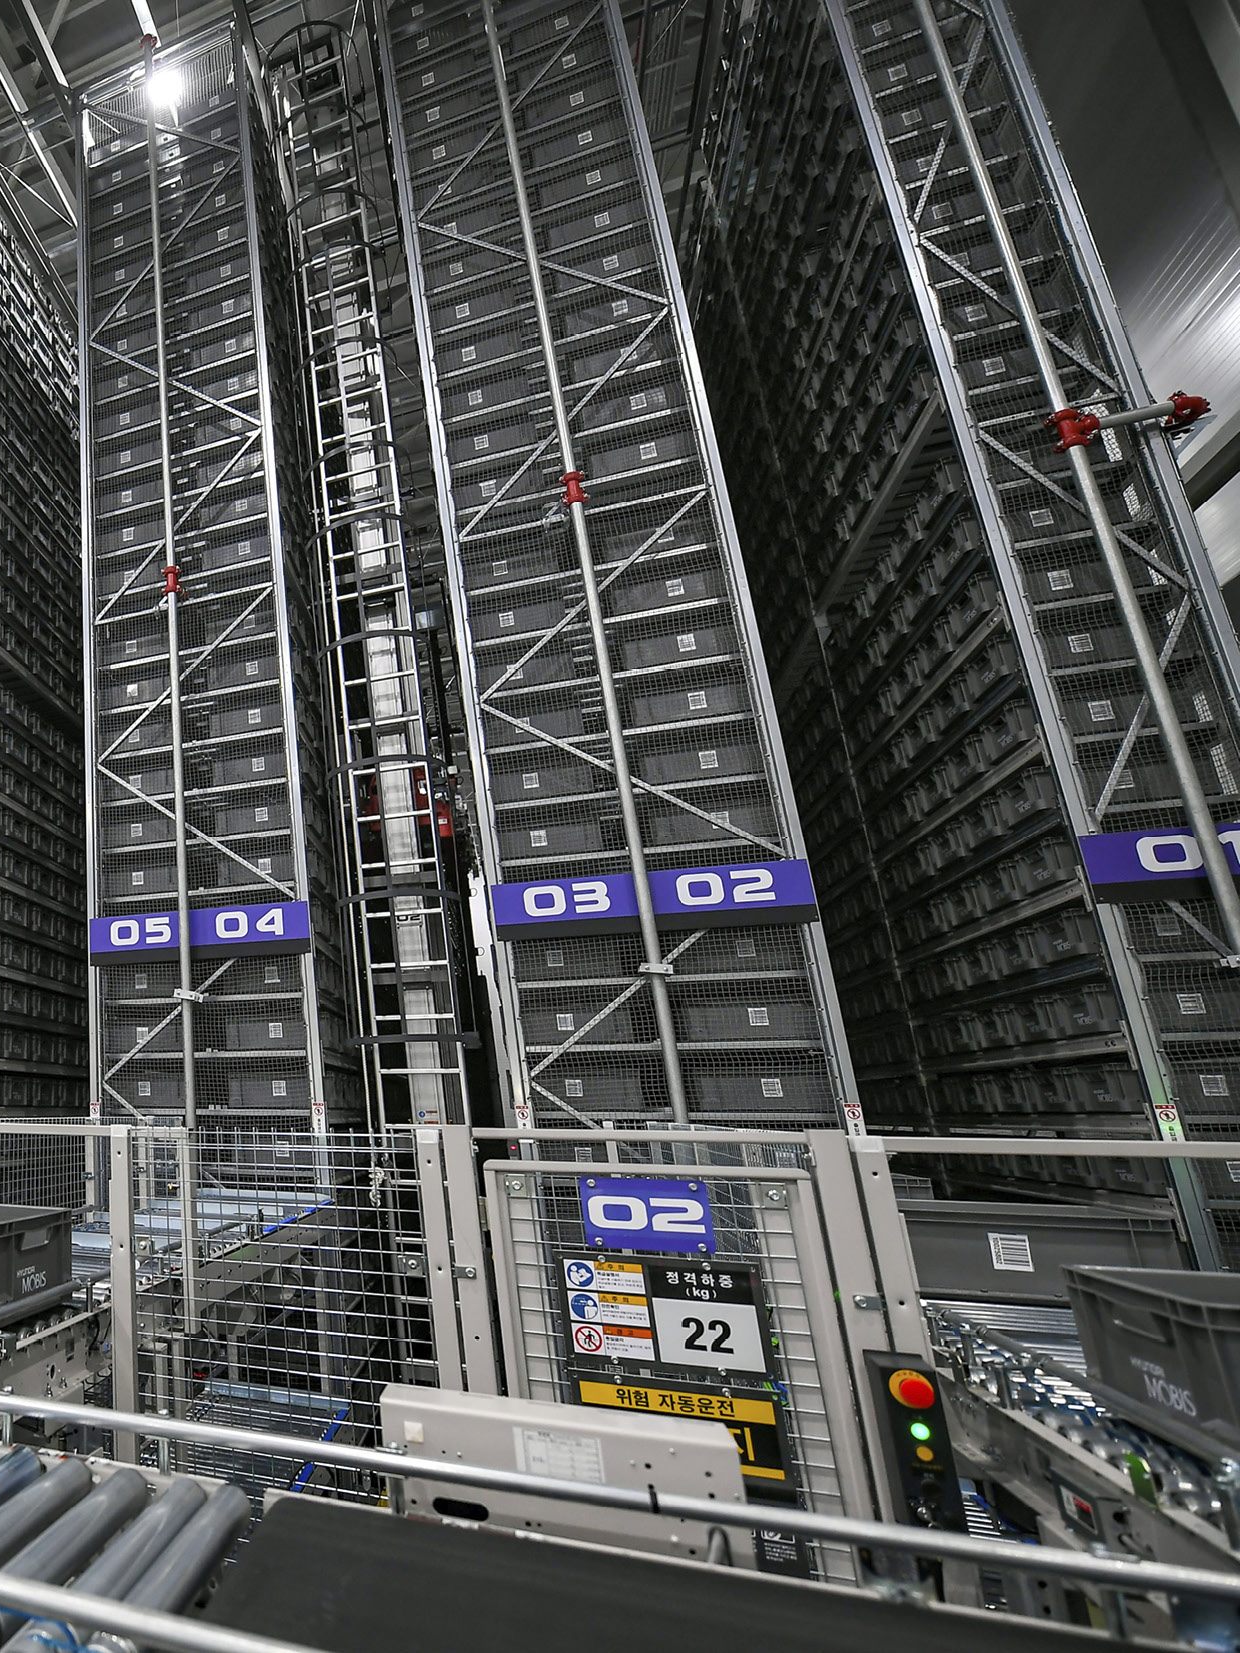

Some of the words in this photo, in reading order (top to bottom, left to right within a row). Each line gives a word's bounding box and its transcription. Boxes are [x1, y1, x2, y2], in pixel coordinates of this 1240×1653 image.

[523, 880, 611, 917] 03
[674, 868, 777, 906] 02
[110, 916, 172, 946] 05
[215, 908, 284, 939] 04
[587, 1195, 706, 1234] 02
[22, 1270, 47, 1294] MOBIS
[665, 1270, 734, 1289] 정격하중
[685, 1287, 717, 1299] (kg)
[680, 1317, 735, 1354] 22
[615, 1387, 650, 1408] 위험
[658, 1392, 735, 1418] 자동운전
[1143, 1374, 1197, 1417] MOBIS
